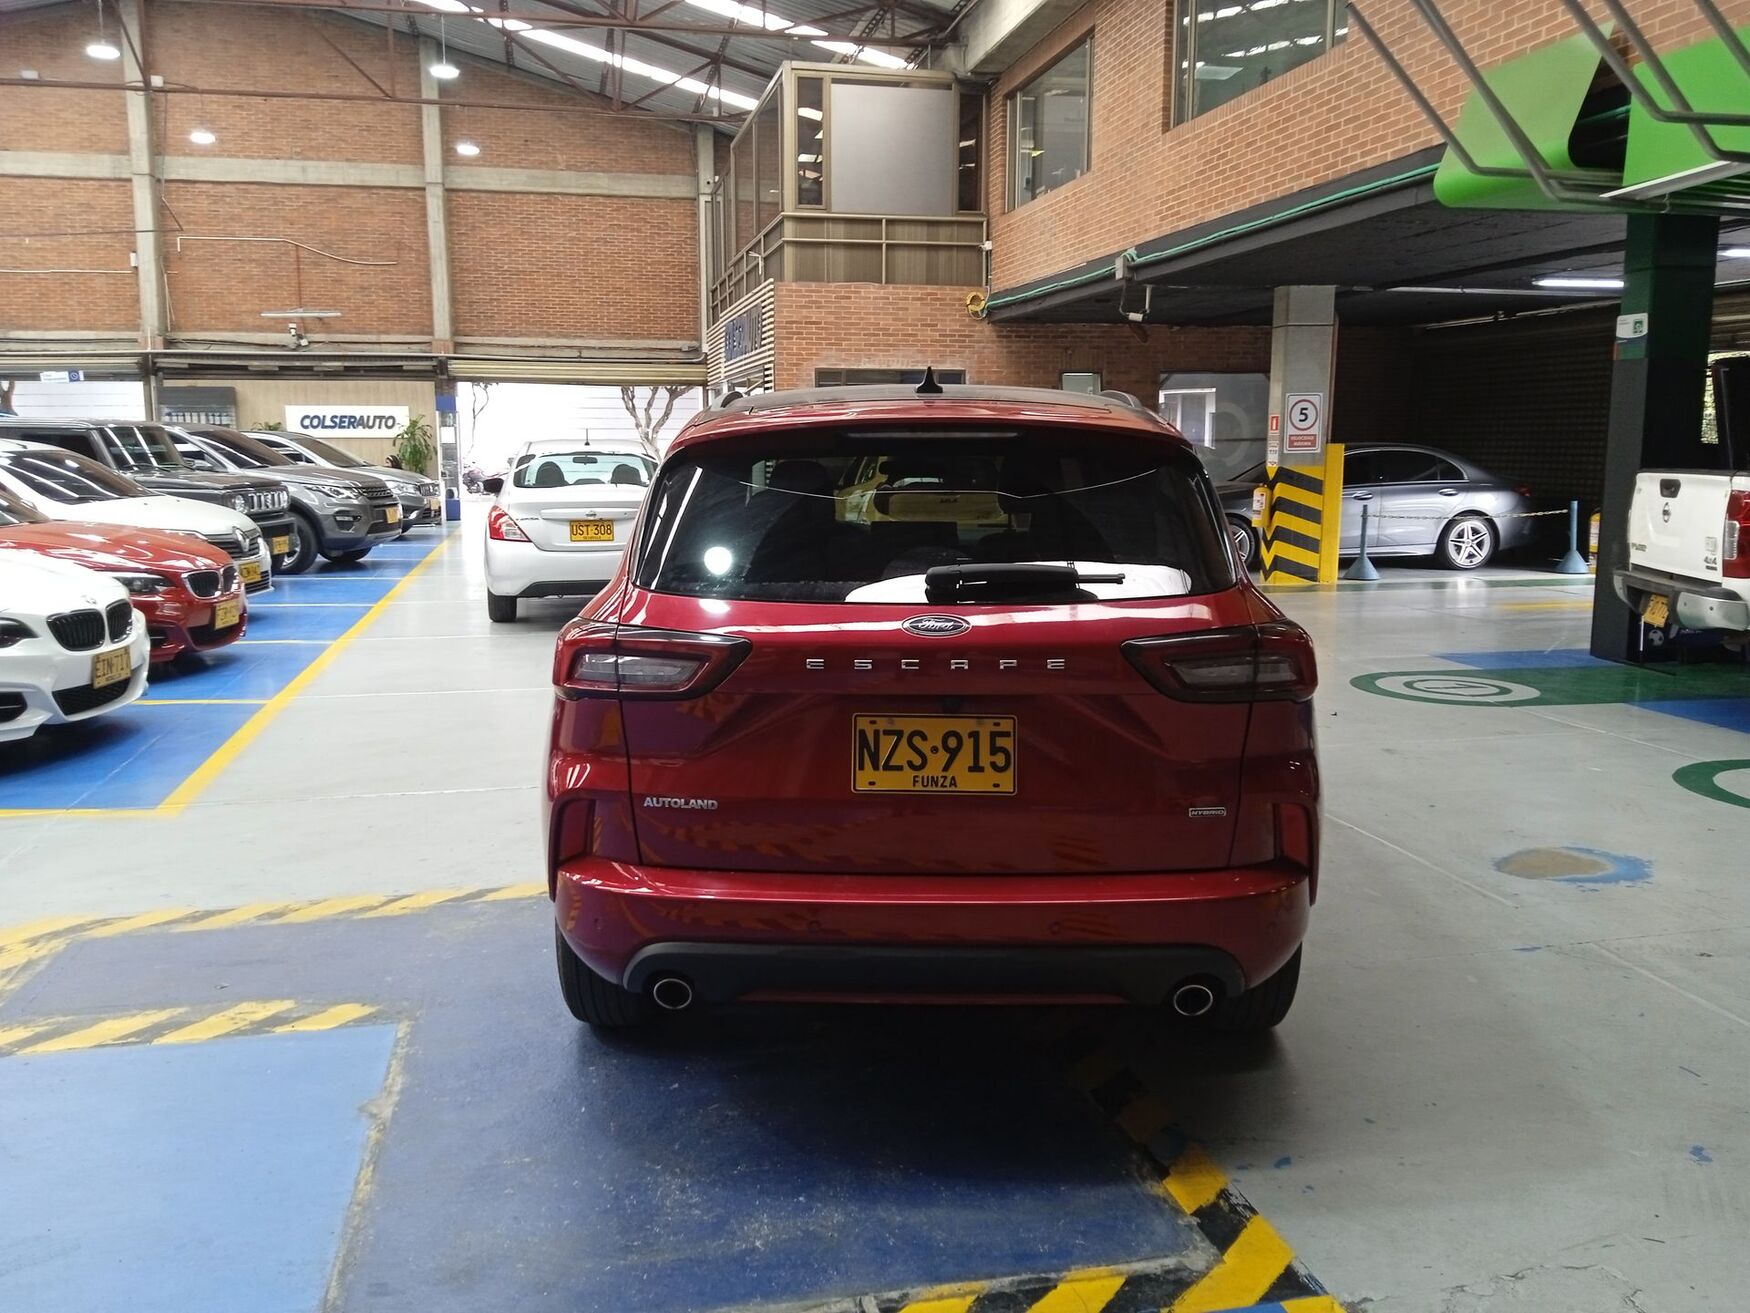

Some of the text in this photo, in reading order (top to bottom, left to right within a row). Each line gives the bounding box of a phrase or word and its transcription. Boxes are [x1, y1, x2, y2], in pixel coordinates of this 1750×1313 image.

[1298, 407, 1309, 422] 5
[299, 414, 396, 430] COLSERAUTO
[917, 617, 955, 631] Ford
[805, 658, 1066, 670] ESCAPE
[912, 775, 959, 789] FUNZA
[643, 796, 719, 810] AUTOLAND
